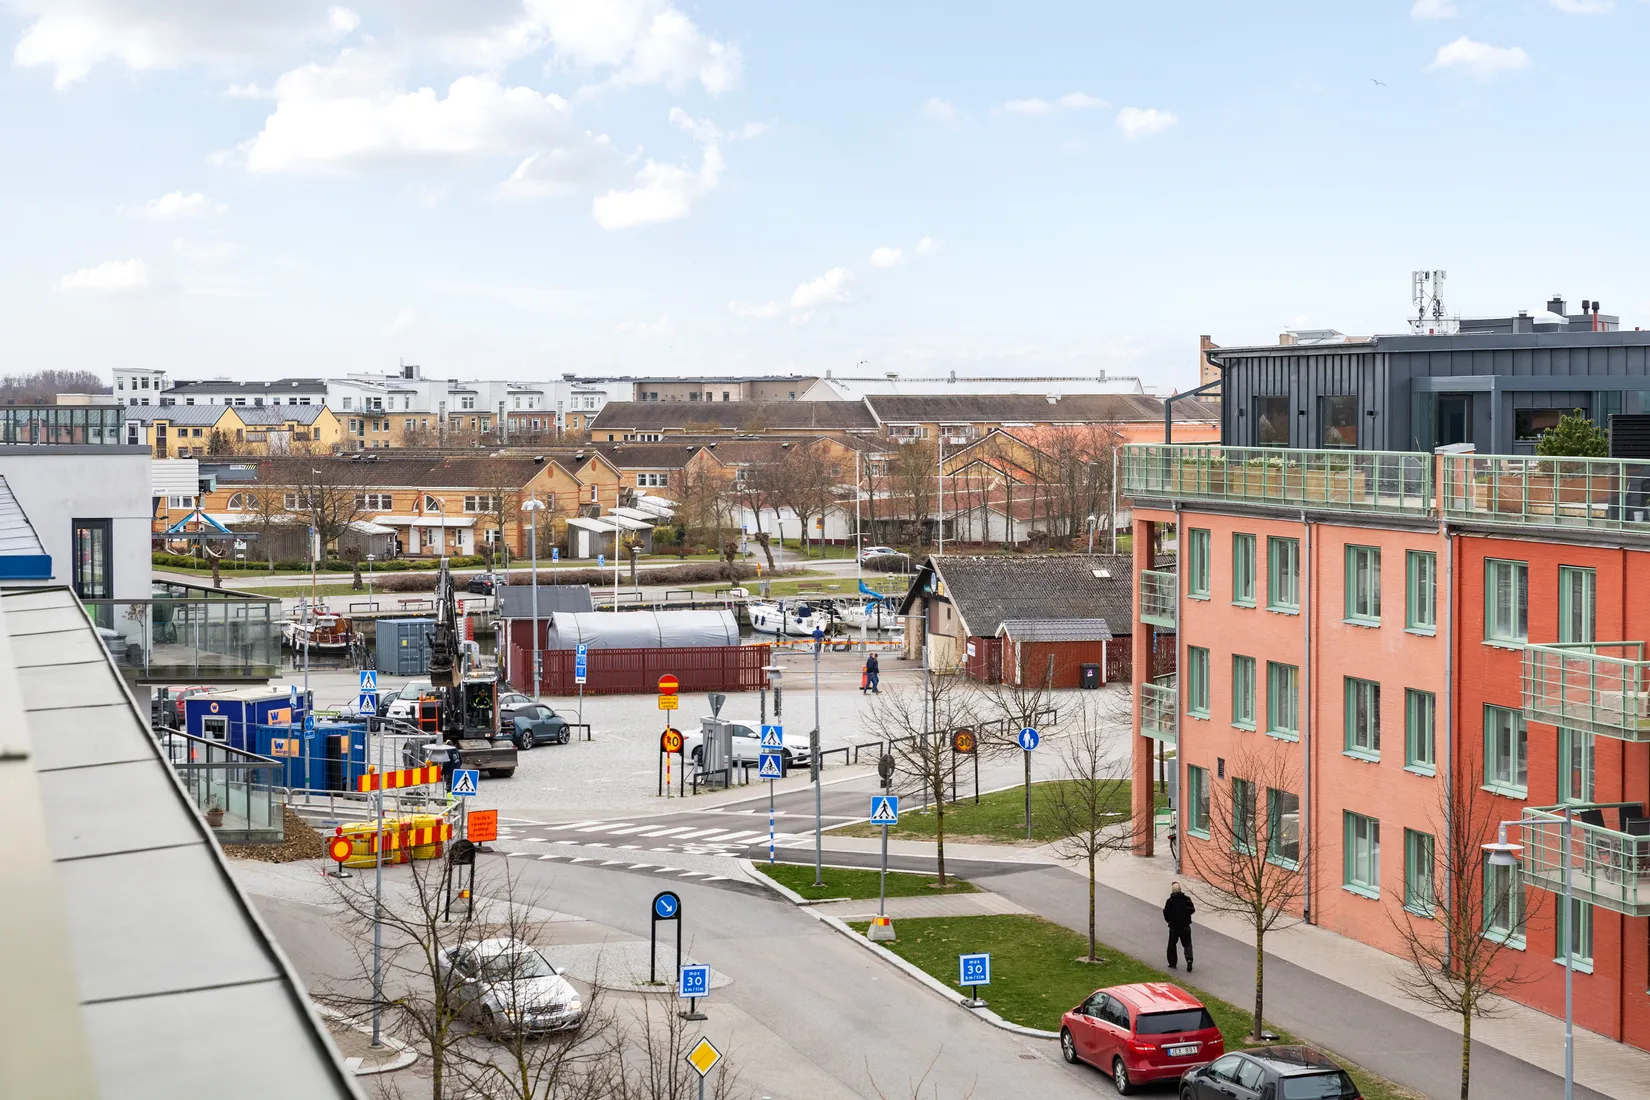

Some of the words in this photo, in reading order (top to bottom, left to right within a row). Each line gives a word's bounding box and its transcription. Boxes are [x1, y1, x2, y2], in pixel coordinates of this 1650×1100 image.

[578, 645, 585, 654] P
[270, 711, 279, 721] W
[273, 740, 284, 749] W
[958, 736, 971, 747] 30
[967, 964, 983, 975] 30
[686, 976, 703, 986] 30
